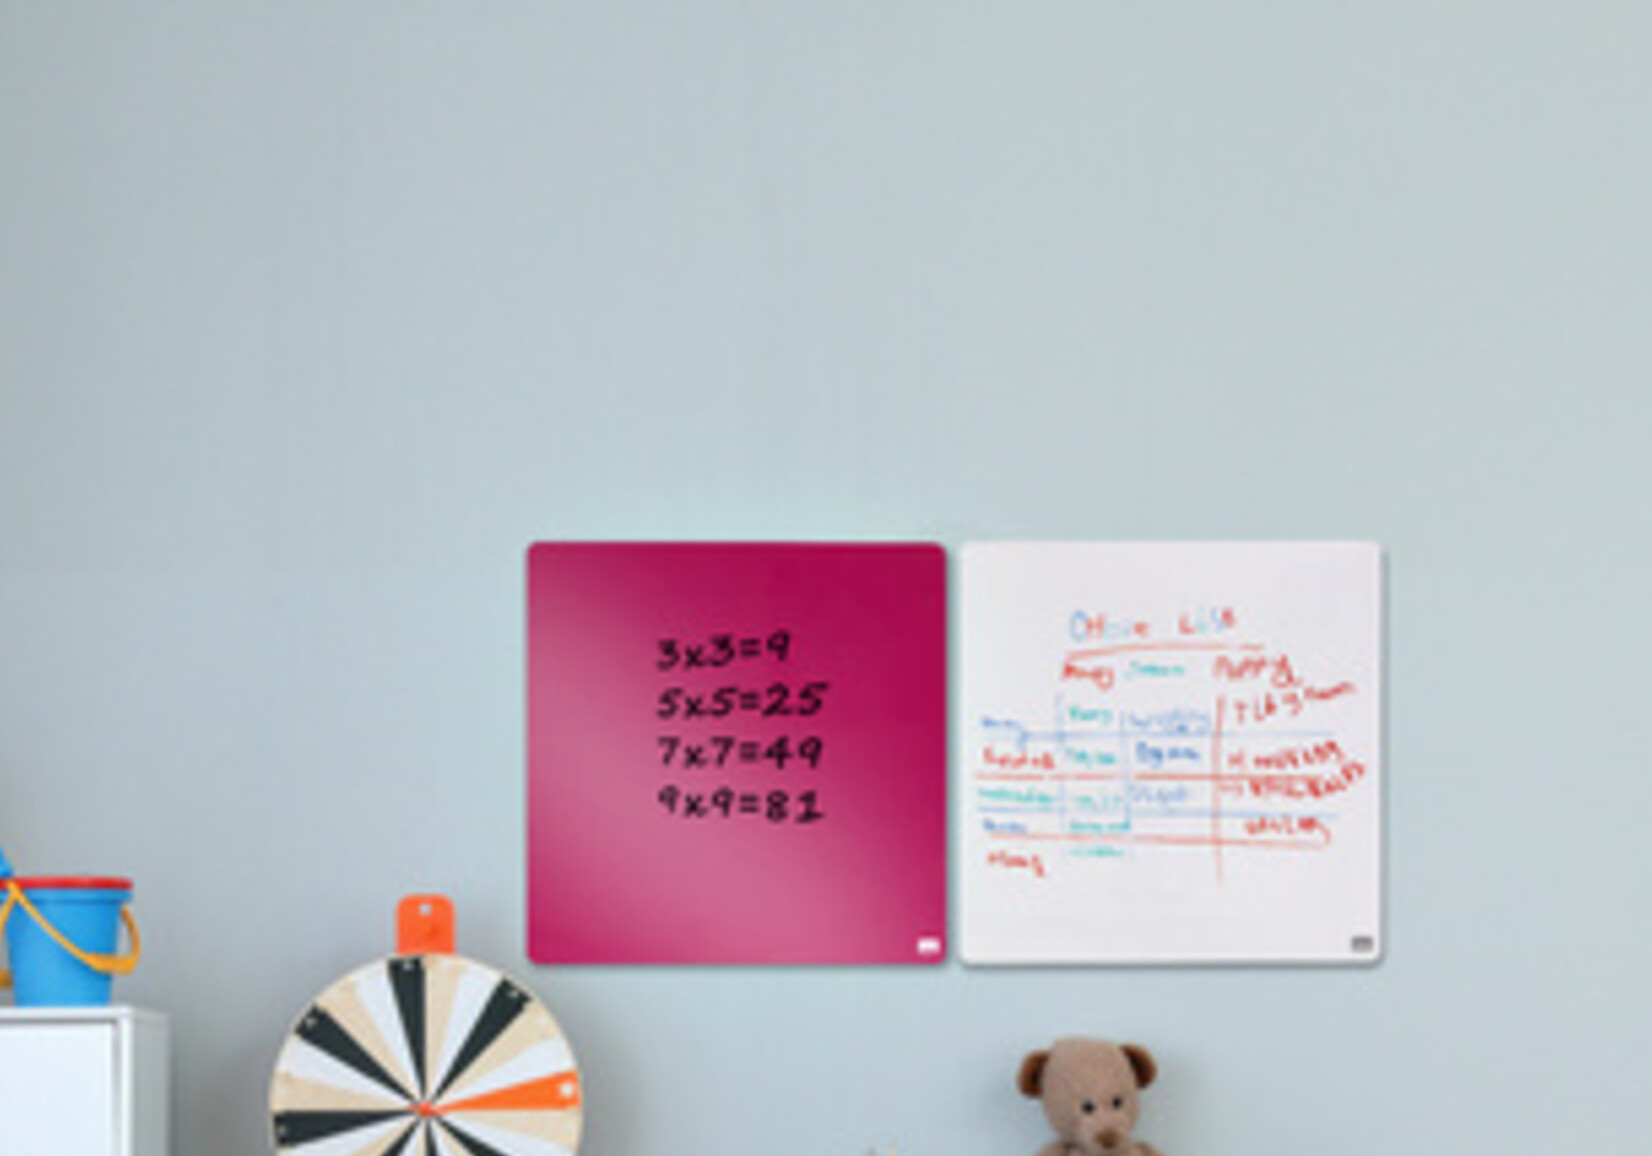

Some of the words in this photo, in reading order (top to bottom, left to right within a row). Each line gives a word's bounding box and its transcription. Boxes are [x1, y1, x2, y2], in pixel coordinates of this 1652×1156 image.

[657, 630, 791, 671] 3x3=9
[657, 681, 829, 720] 5x5=25
[657, 735, 823, 770] 7x7=49
[657, 784, 825, 824] 9x9=81
